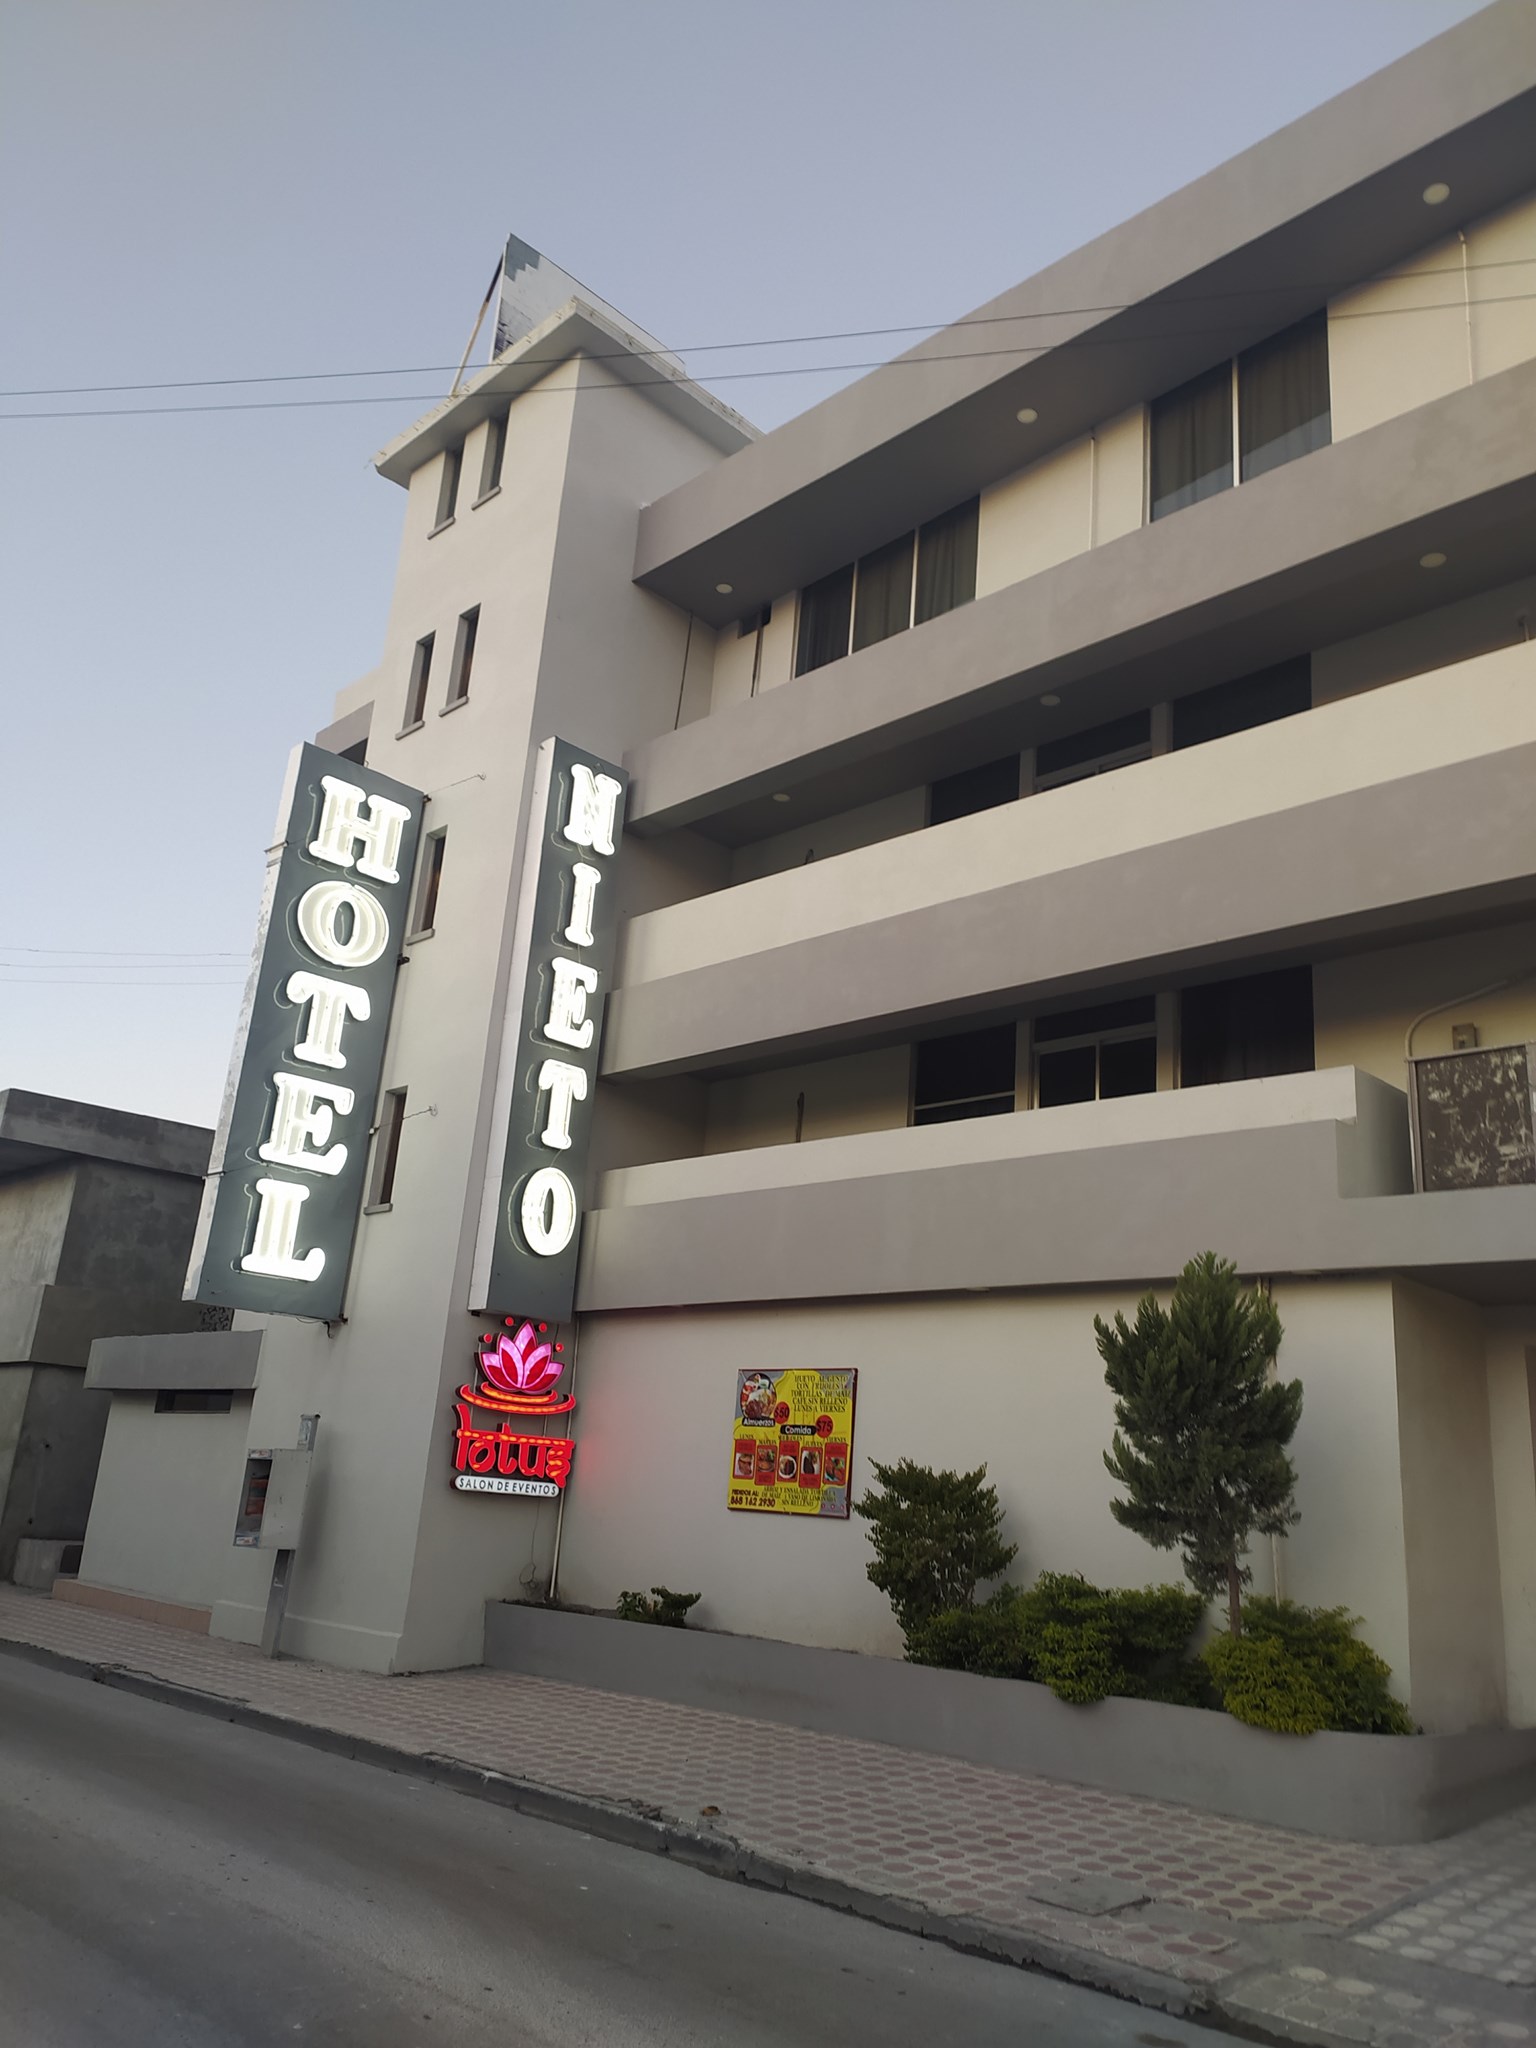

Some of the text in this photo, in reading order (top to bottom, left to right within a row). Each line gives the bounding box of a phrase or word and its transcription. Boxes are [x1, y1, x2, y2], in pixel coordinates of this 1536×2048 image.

[521, 763, 622, 1256] NIETO
[241, 775, 412, 1282] HOTEL
[820, 1397, 848, 1406] RELLENO
[774, 1406, 790, 1418] $50
[819, 1404, 845, 1413] VIERNES
[743, 1418, 774, 1427] Almuerzos
[817, 1419, 833, 1434] $75
[785, 1426, 812, 1435] Comida
[459, 1477, 557, 1496] SALON DE EVENTOS
[744, 1497, 756, 1506] 162
